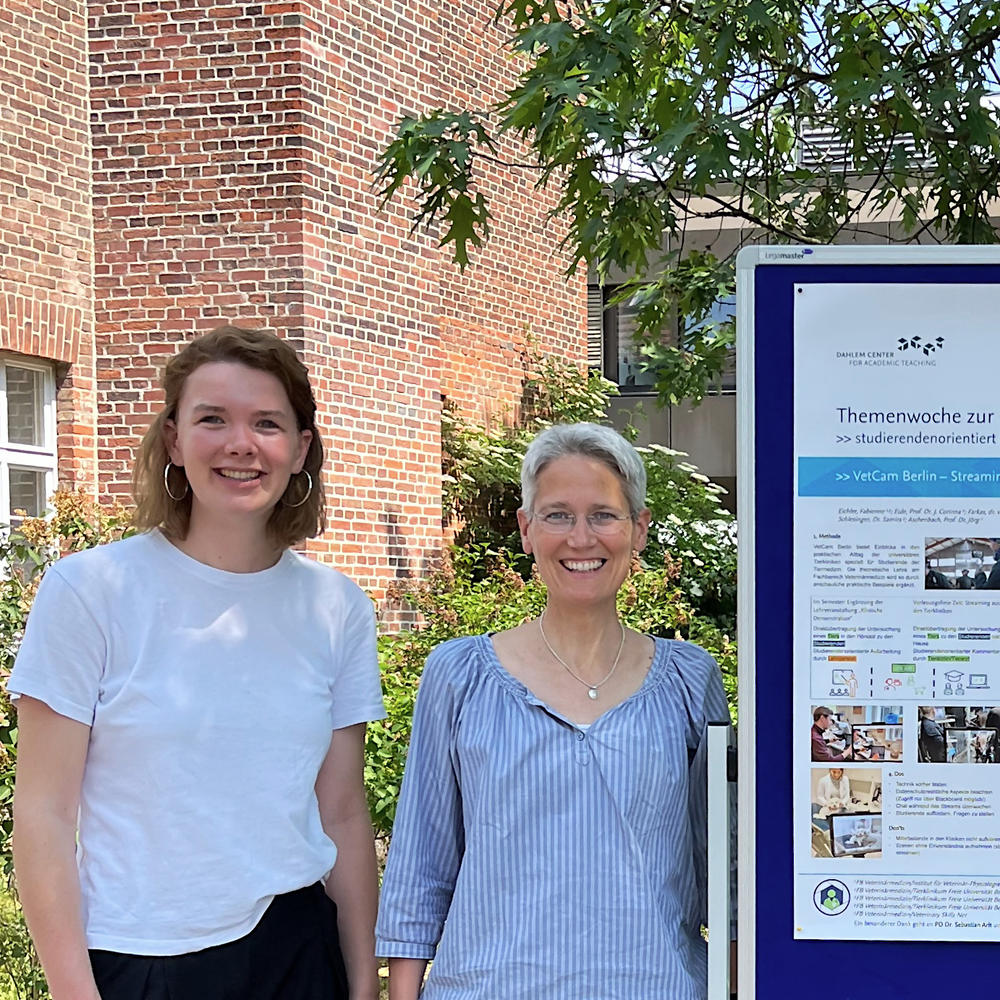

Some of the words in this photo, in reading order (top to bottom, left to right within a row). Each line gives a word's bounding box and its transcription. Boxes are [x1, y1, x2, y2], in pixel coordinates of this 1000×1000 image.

[836, 407, 961, 424] Themenwoche
[967, 411, 994, 424] zur
[855, 431, 996, 444] studierendenorientiert
[852, 470, 899, 482] VetCam
[902, 470, 937, 482] Berlin
